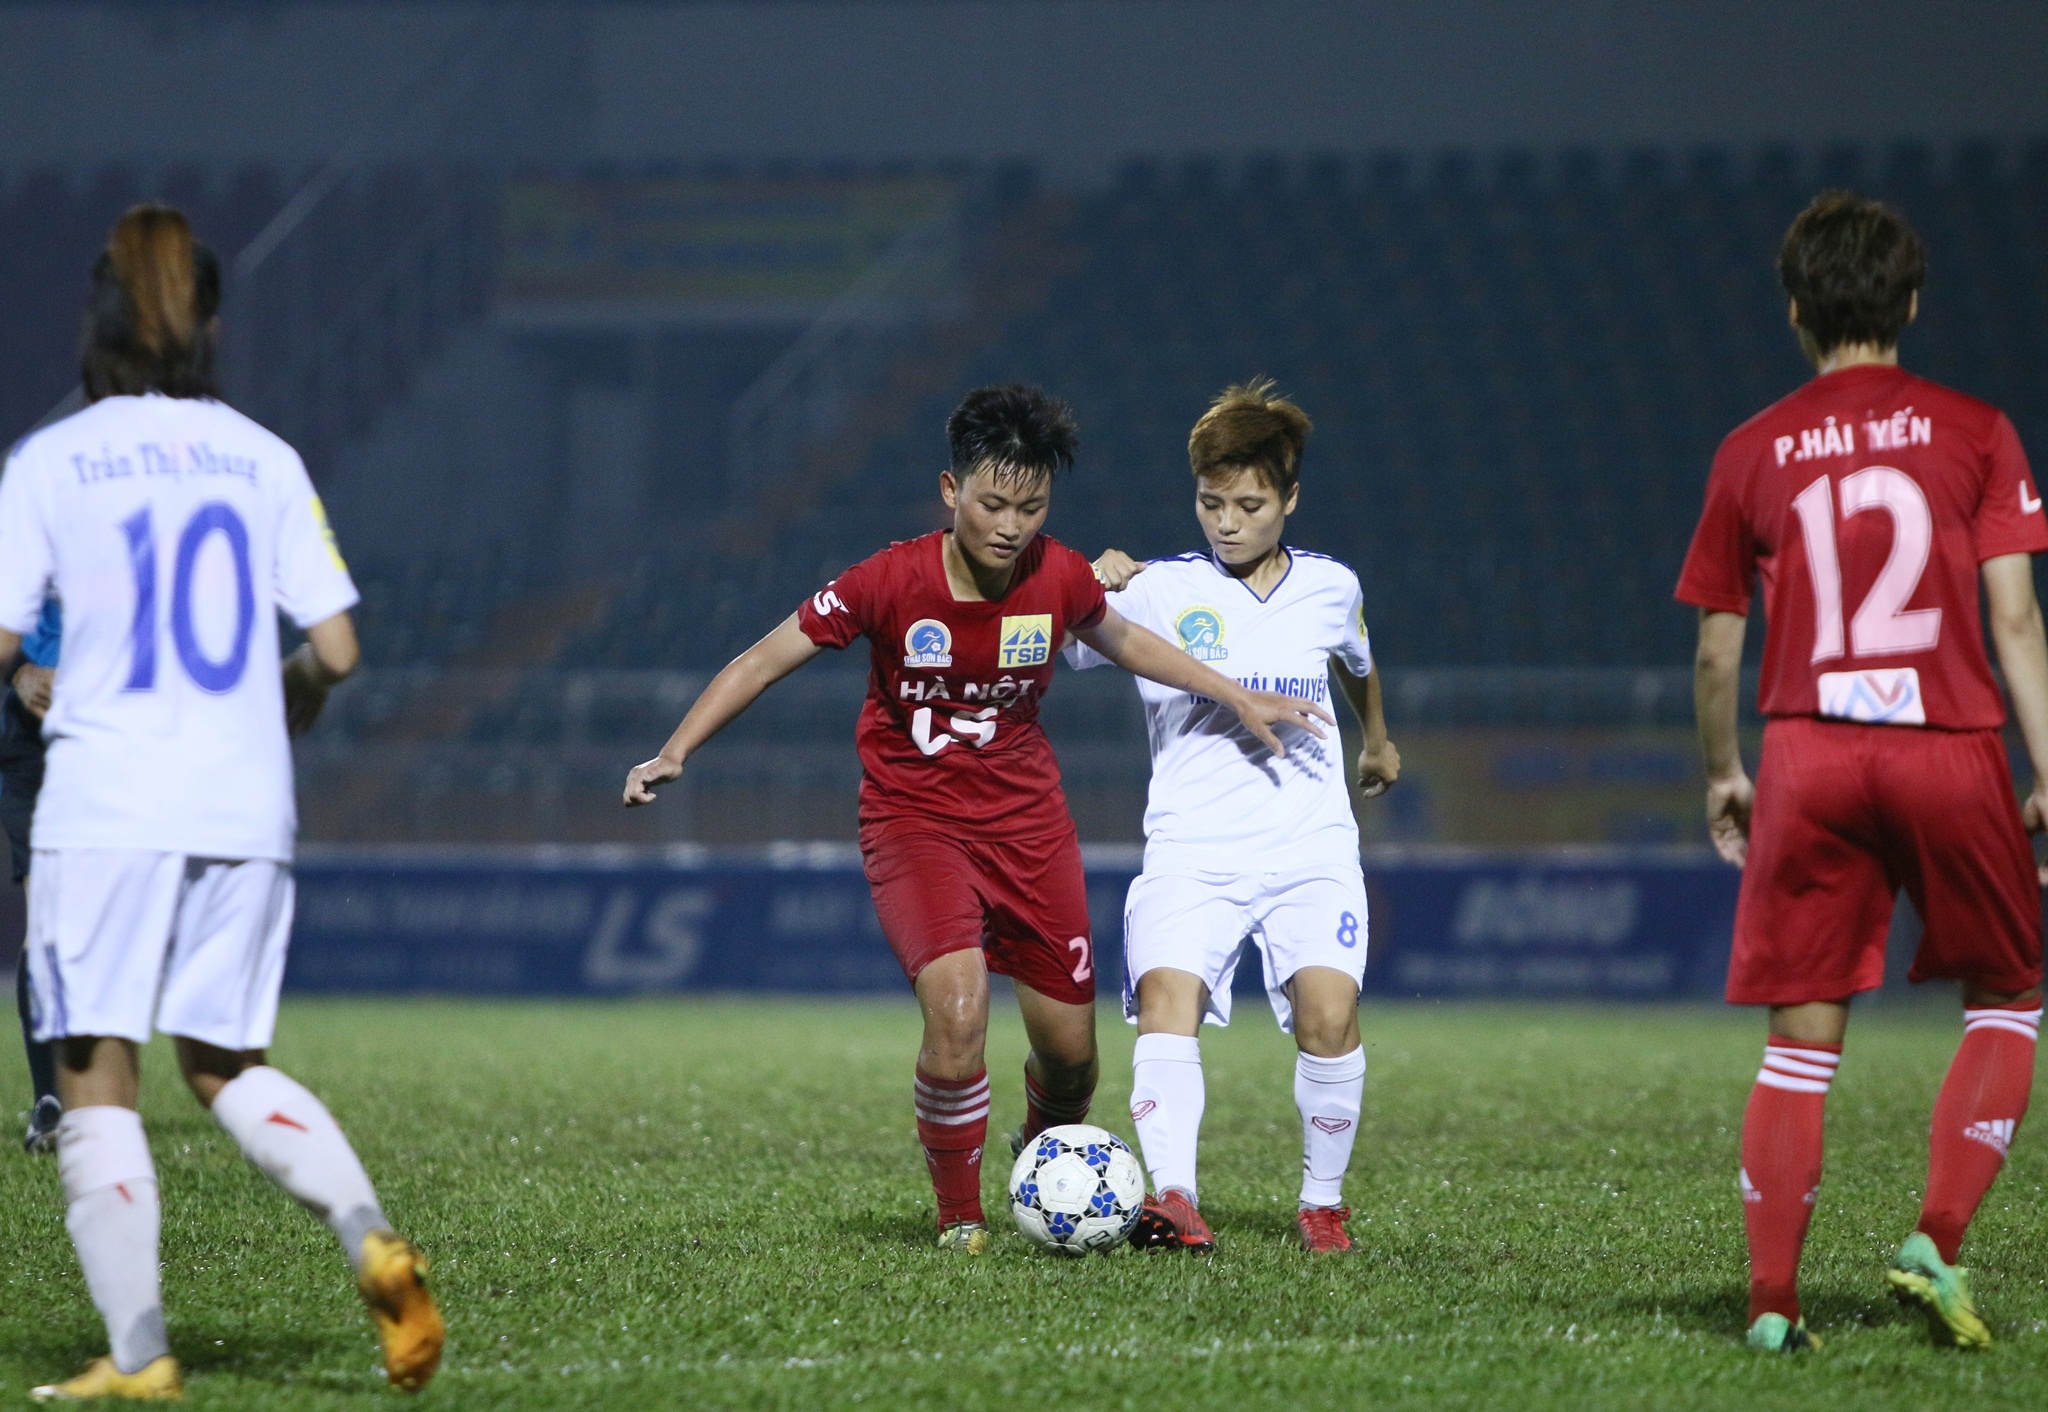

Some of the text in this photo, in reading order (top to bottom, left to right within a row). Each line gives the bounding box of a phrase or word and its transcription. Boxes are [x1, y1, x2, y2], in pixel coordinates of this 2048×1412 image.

[1774, 405, 1932, 468] P.HẢI YẾN
[1791, 464, 1942, 666] 12
[117, 500, 256, 696] 10
[1002, 646, 1047, 665] TSB
[900, 675, 951, 701] HÀ
[1336, 911, 1359, 949] 8
[1068, 932, 1094, 983] 2
